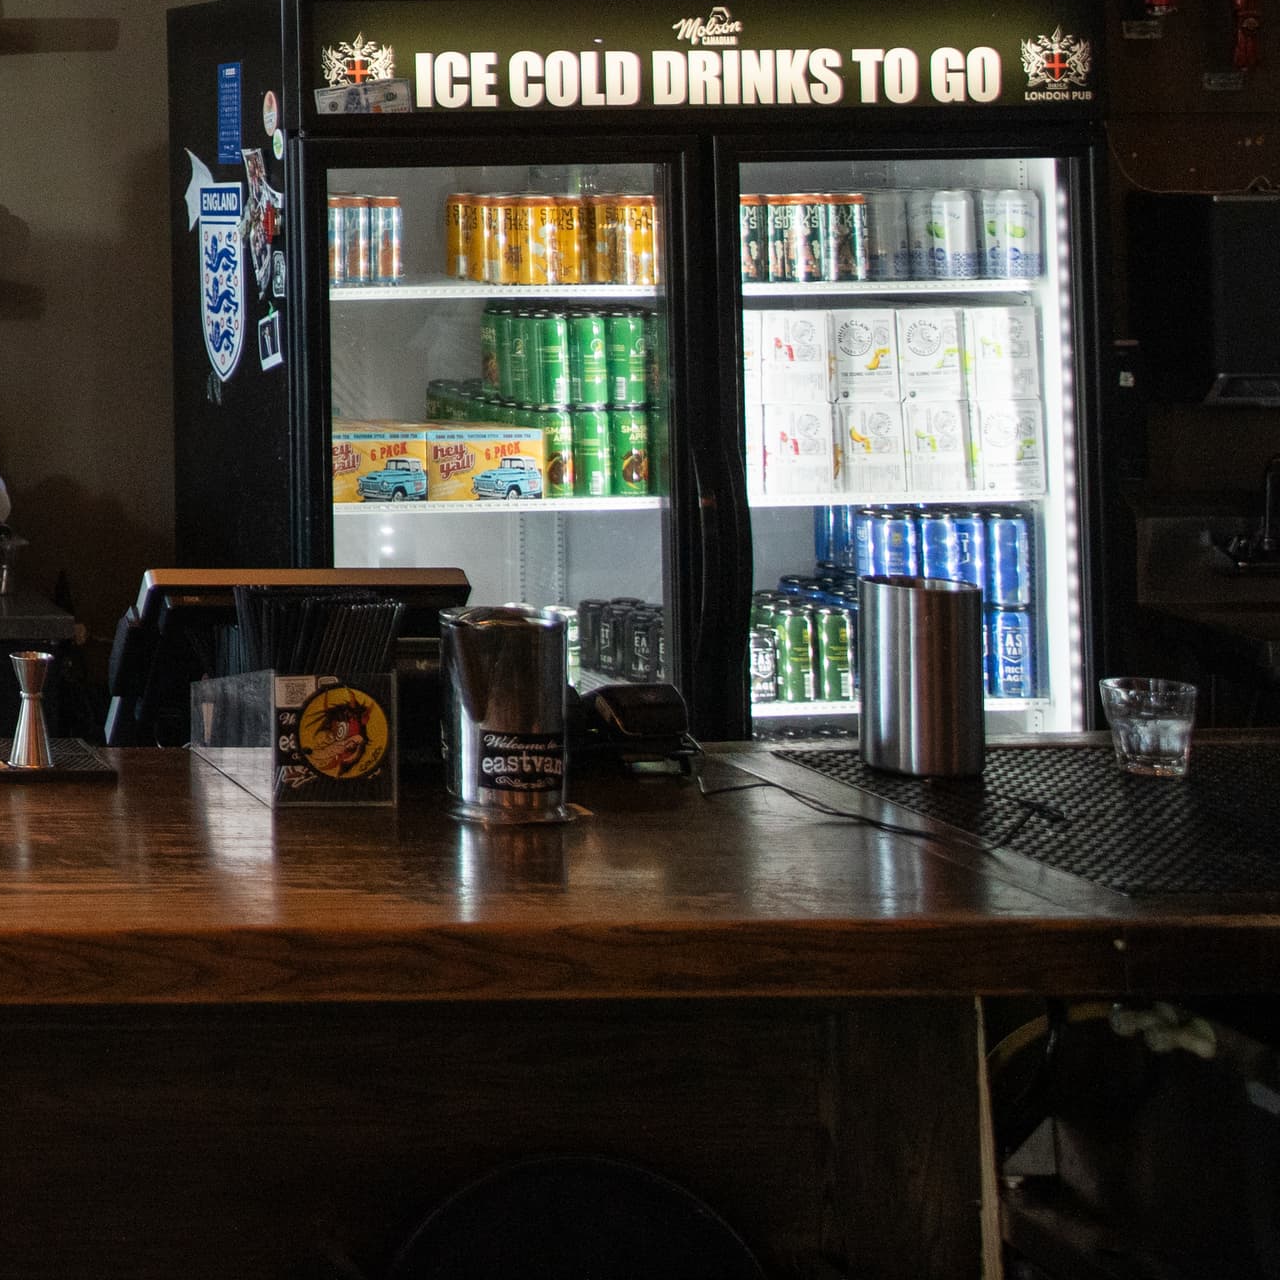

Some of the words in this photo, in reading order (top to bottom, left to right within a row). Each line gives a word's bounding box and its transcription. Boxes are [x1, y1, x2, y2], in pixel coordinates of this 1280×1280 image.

[672, 17, 742, 45] Molson
[702, 36, 737, 46] CANADIAN
[414, 51, 500, 109] ICE
[508, 50, 641, 108] COLD
[651, 47, 844, 106] DRINKS
[851, 47, 920, 105] TO
[930, 46, 1003, 104] GO
[1024, 91, 1069, 102] LONDON
[1071, 91, 1094, 101] PUB
[201, 192, 238, 212] ENGLAND
[370, 448, 378, 462] 6
[379, 441, 409, 460] PACK
[485, 447, 492, 461] 6
[493, 441, 521, 459] PACK
[483, 733, 544, 751] Welcome
[481, 750, 563, 777] eastvan
